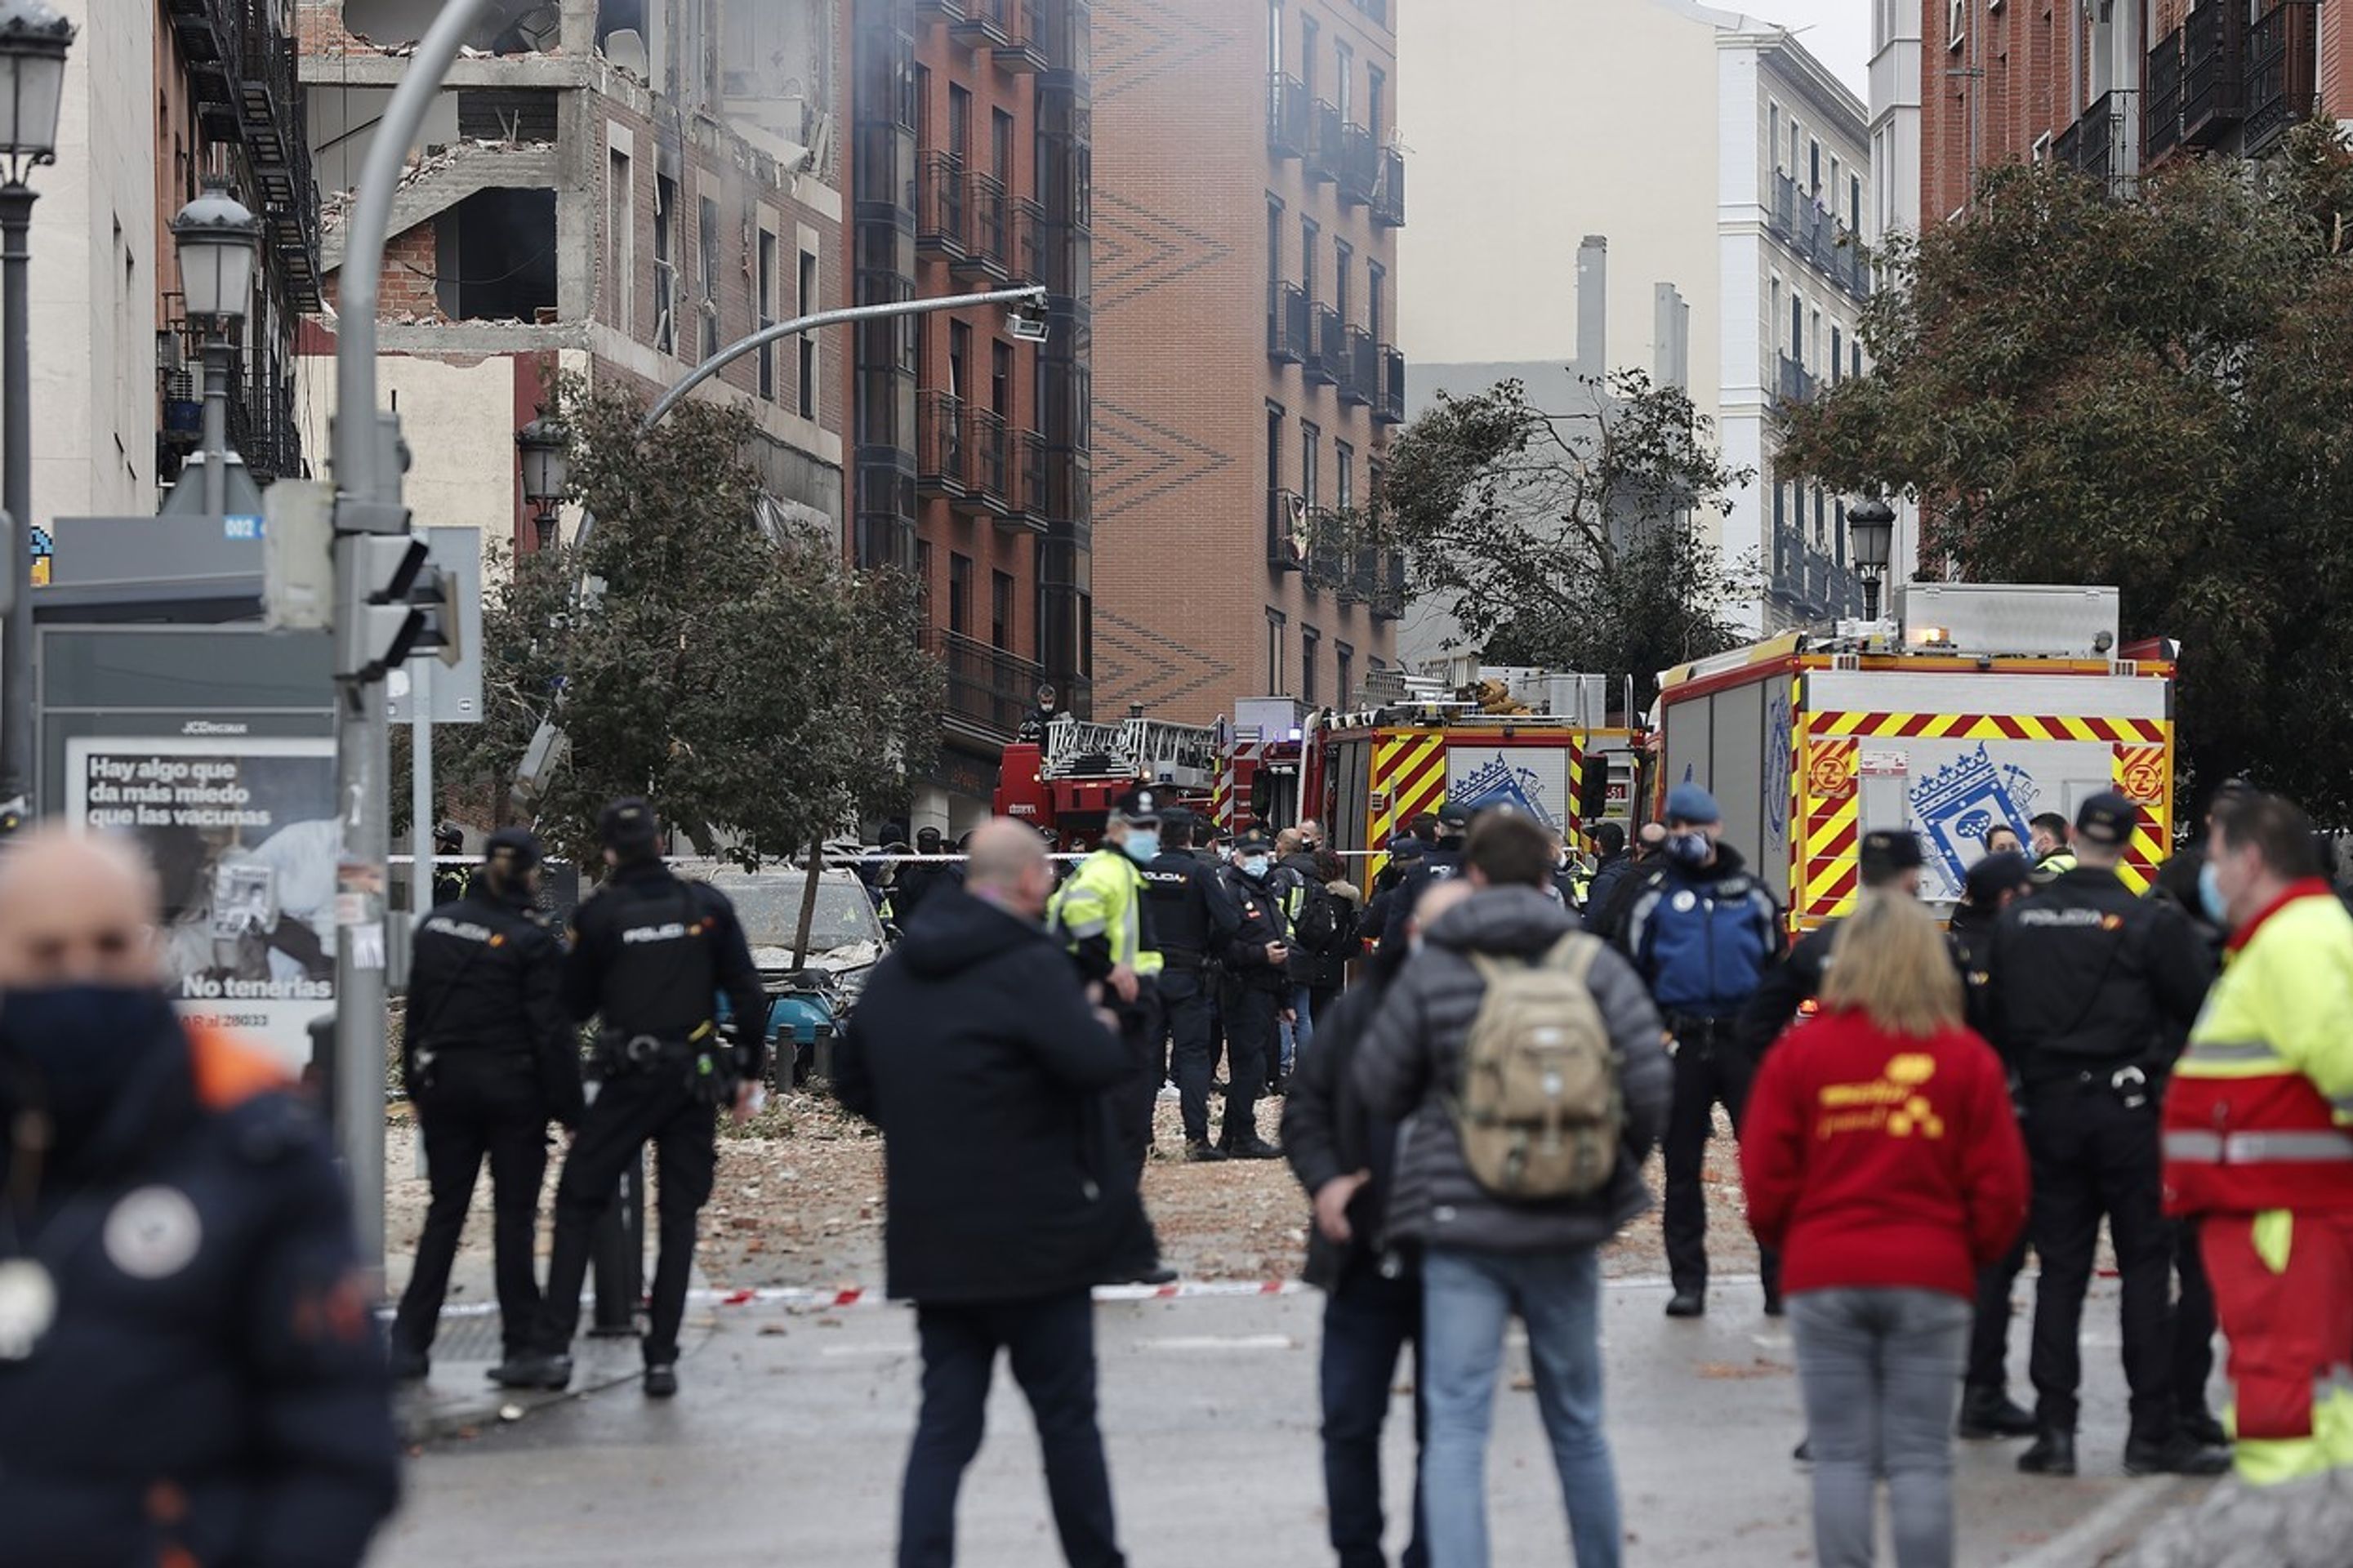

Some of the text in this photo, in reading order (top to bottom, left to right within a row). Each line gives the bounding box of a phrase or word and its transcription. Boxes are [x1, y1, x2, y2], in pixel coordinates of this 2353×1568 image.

[90, 756, 236, 782] Hay algo que
[89, 781, 249, 803] da más miedo
[88, 804, 271, 828] que las vacunas
[183, 975, 332, 997] No tenerlas
